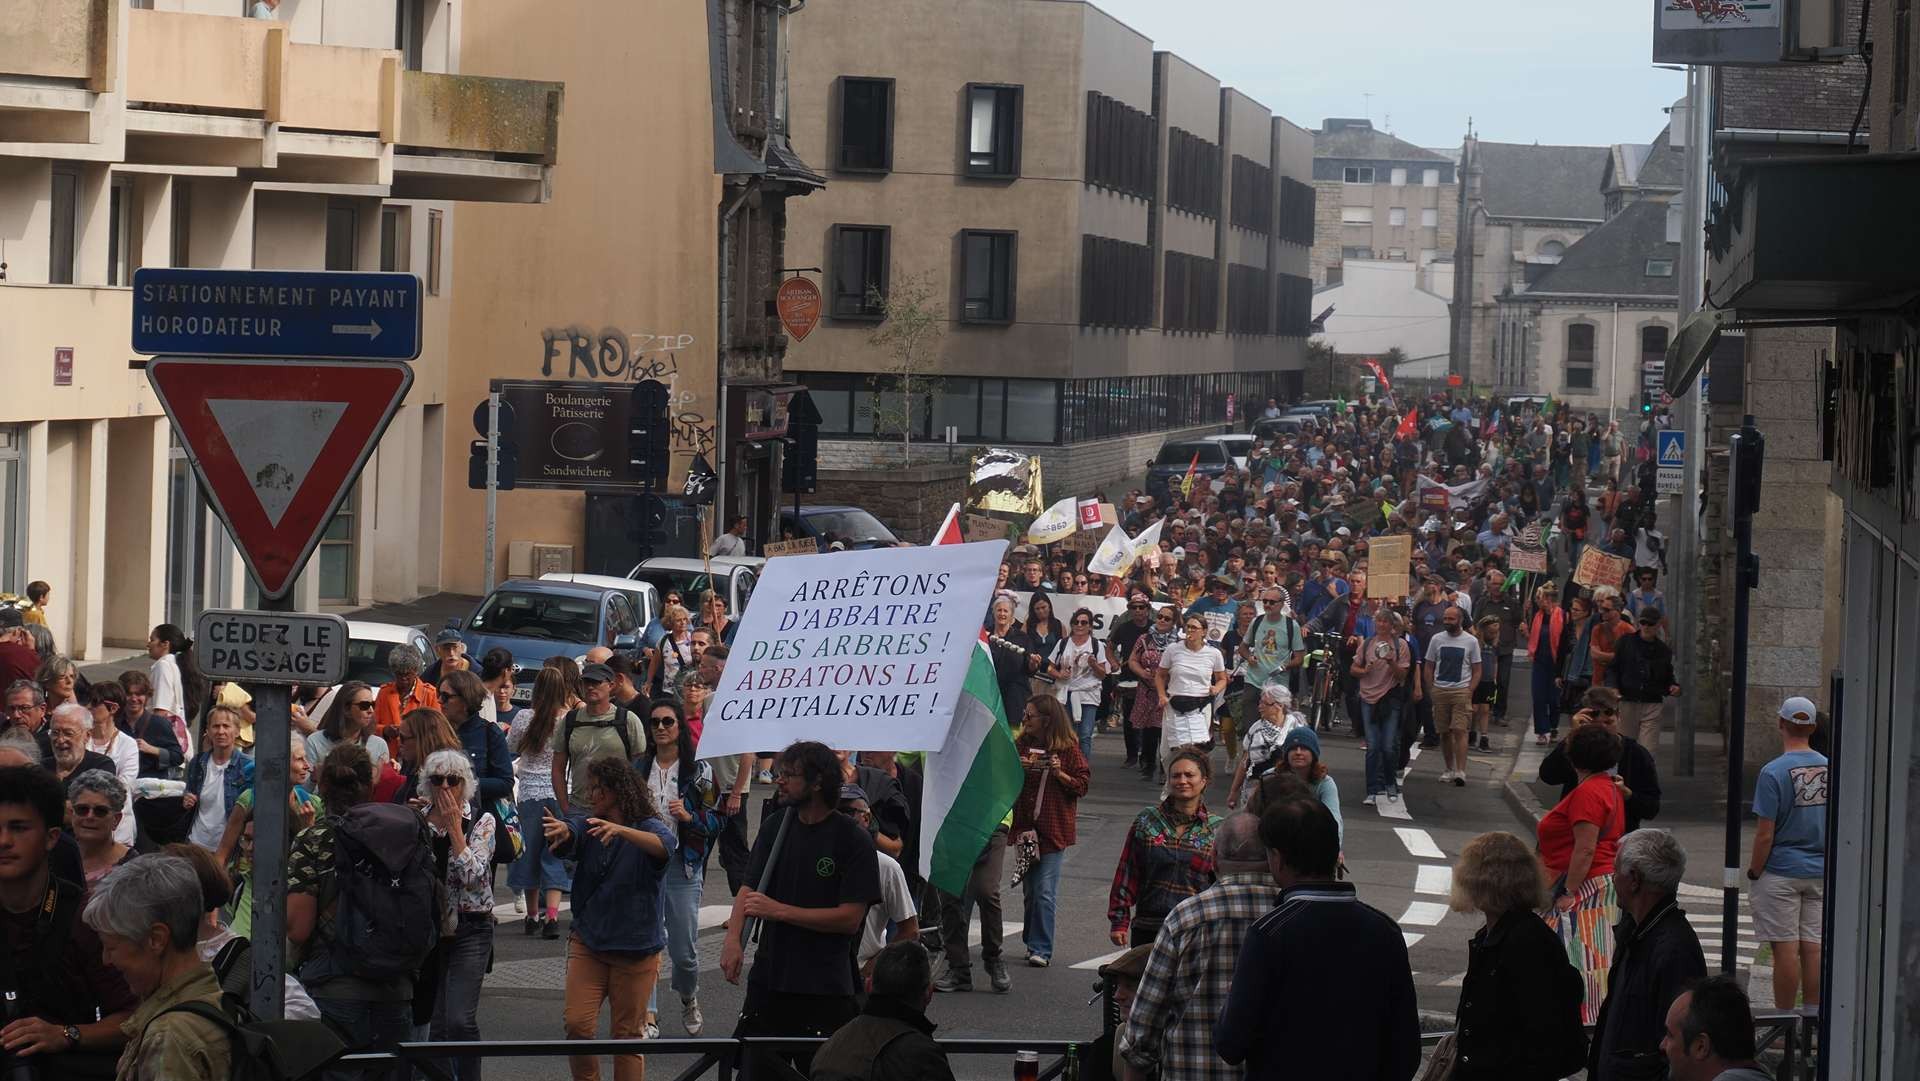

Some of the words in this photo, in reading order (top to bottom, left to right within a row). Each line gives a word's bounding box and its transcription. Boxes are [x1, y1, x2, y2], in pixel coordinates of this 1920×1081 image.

[143, 284, 315, 306] STATIONNEMENT
[330, 288, 407, 308] PAYANT
[141, 315, 281, 337] HORODATEUR
[545, 392, 612, 407] Boulangerie
[552, 406, 605, 419] Pâtisserie
[543, 464, 613, 477] Sandwicherie
[789, 569, 950, 602] ARRÊTONS
[778, 602, 942, 631] D'ABBATRE
[209, 617, 290, 645] CÉDEZ
[303, 625, 331, 648] LE
[748, 638, 805, 661] DES
[812, 632, 932, 657] ARBRES
[941, 631, 951, 653] !
[211, 648, 327, 674] PASSAGE
[736, 664, 896, 691] ABBATONS
[905, 662, 942, 685] LE
[720, 693, 920, 721] CAPITALISME
[928, 692, 939, 714] !
